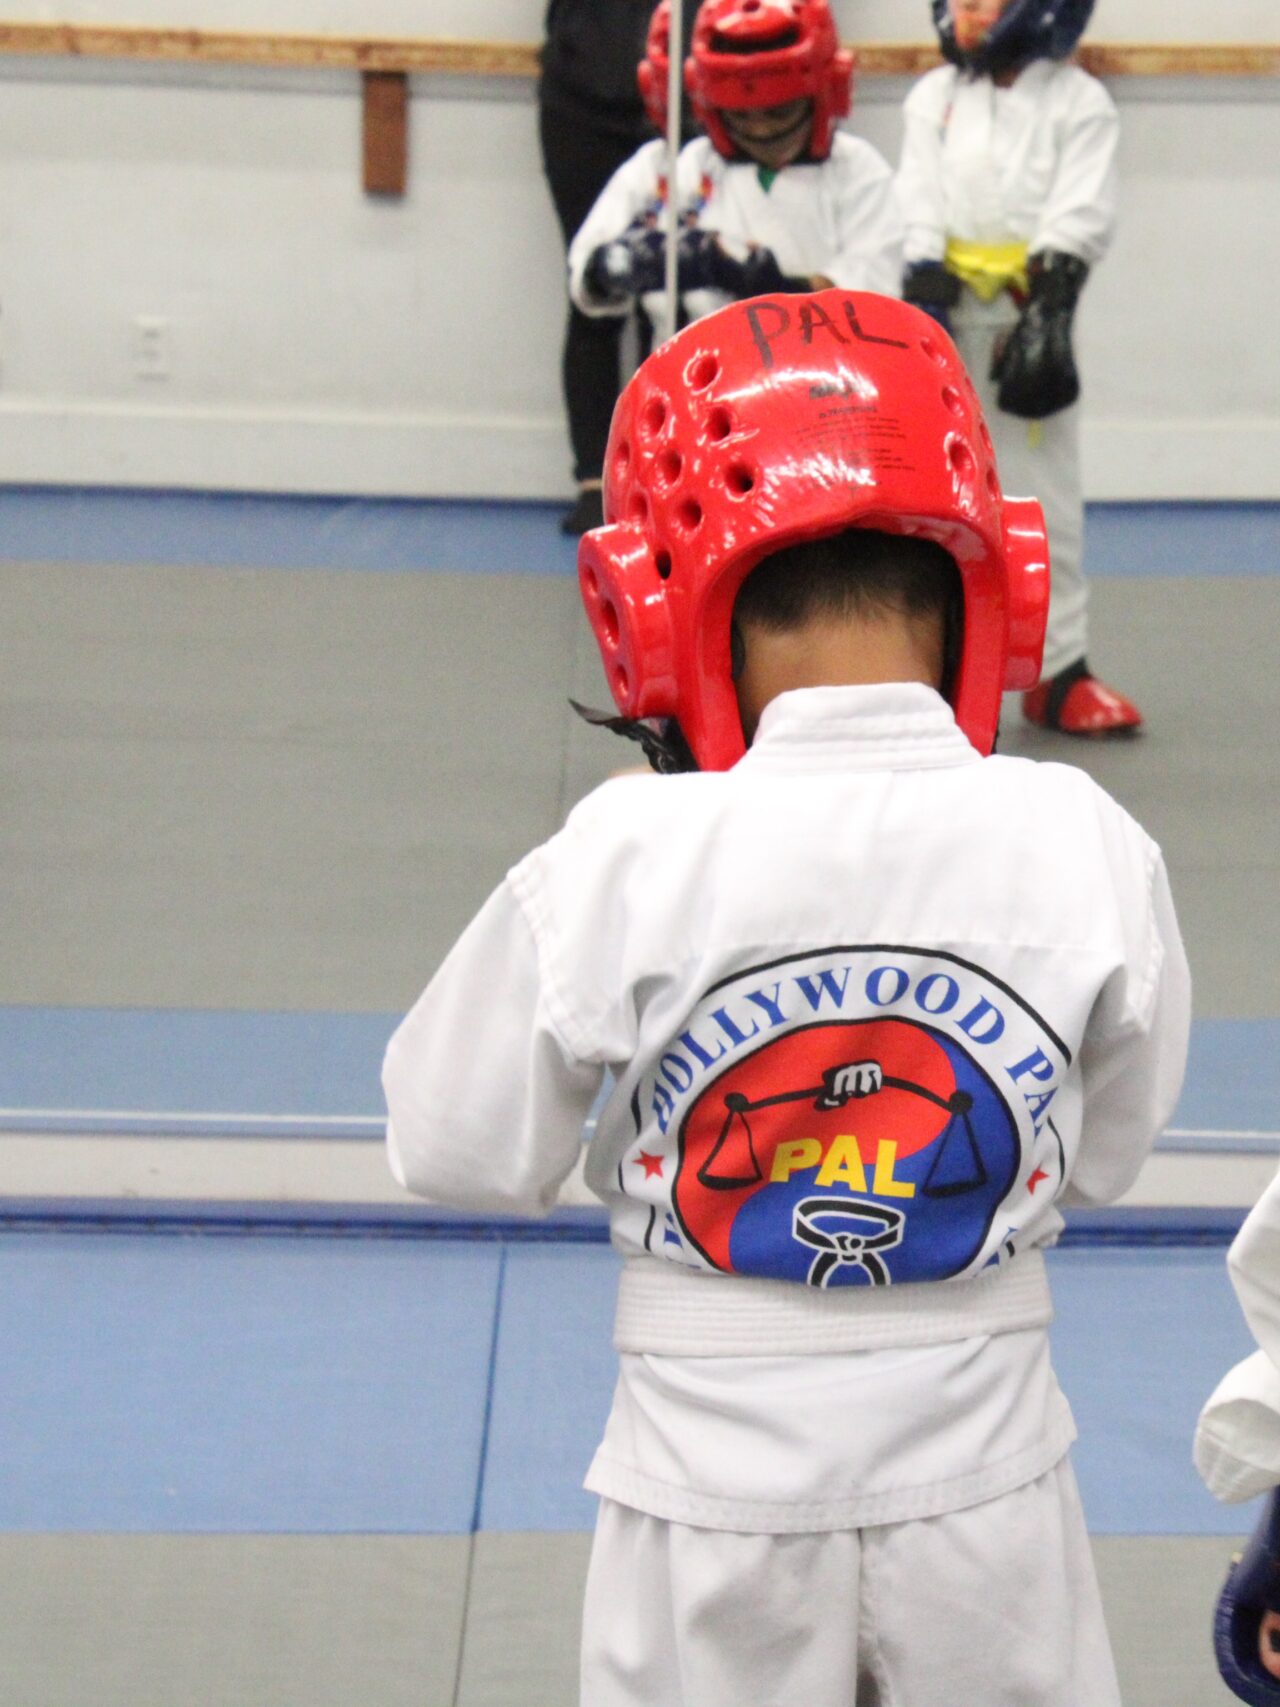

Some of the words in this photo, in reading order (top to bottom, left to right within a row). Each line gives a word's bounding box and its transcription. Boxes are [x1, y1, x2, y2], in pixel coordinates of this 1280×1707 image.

[745, 300, 909, 369] PAL
[1004, 1045, 1058, 1140] PA
[769, 1134, 915, 1198] PAL
